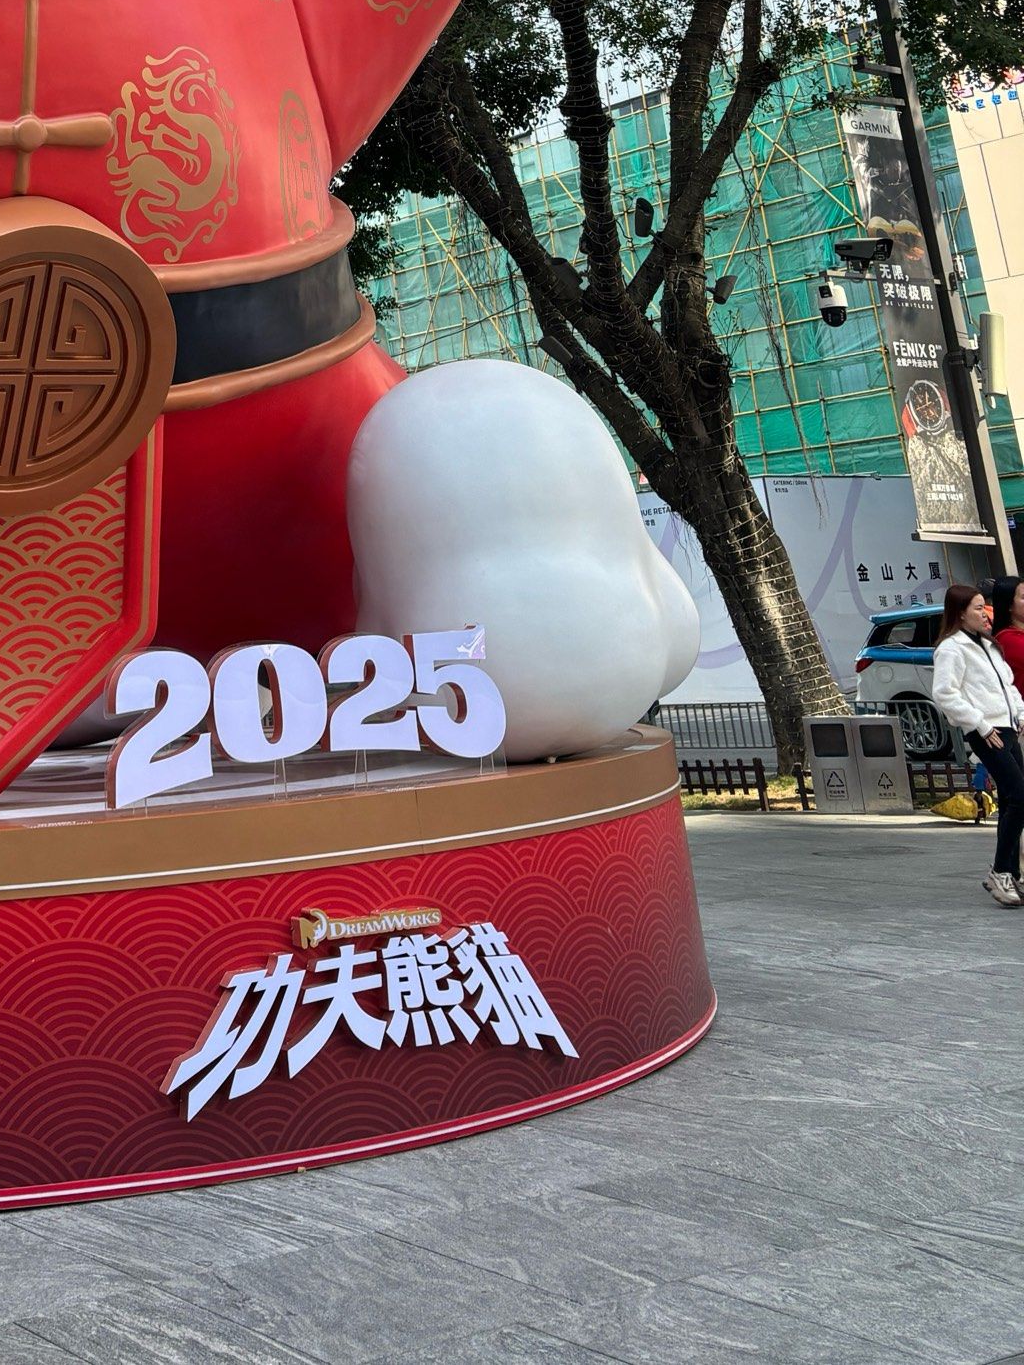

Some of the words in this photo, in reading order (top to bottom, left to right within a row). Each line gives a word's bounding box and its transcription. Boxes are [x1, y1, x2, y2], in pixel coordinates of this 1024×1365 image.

[850, 120, 891, 134] GARMIN
[883, 283, 933, 302] 突破极限
[856, 561, 943, 582] 金山大厦
[110, 622, 507, 810] 2025
